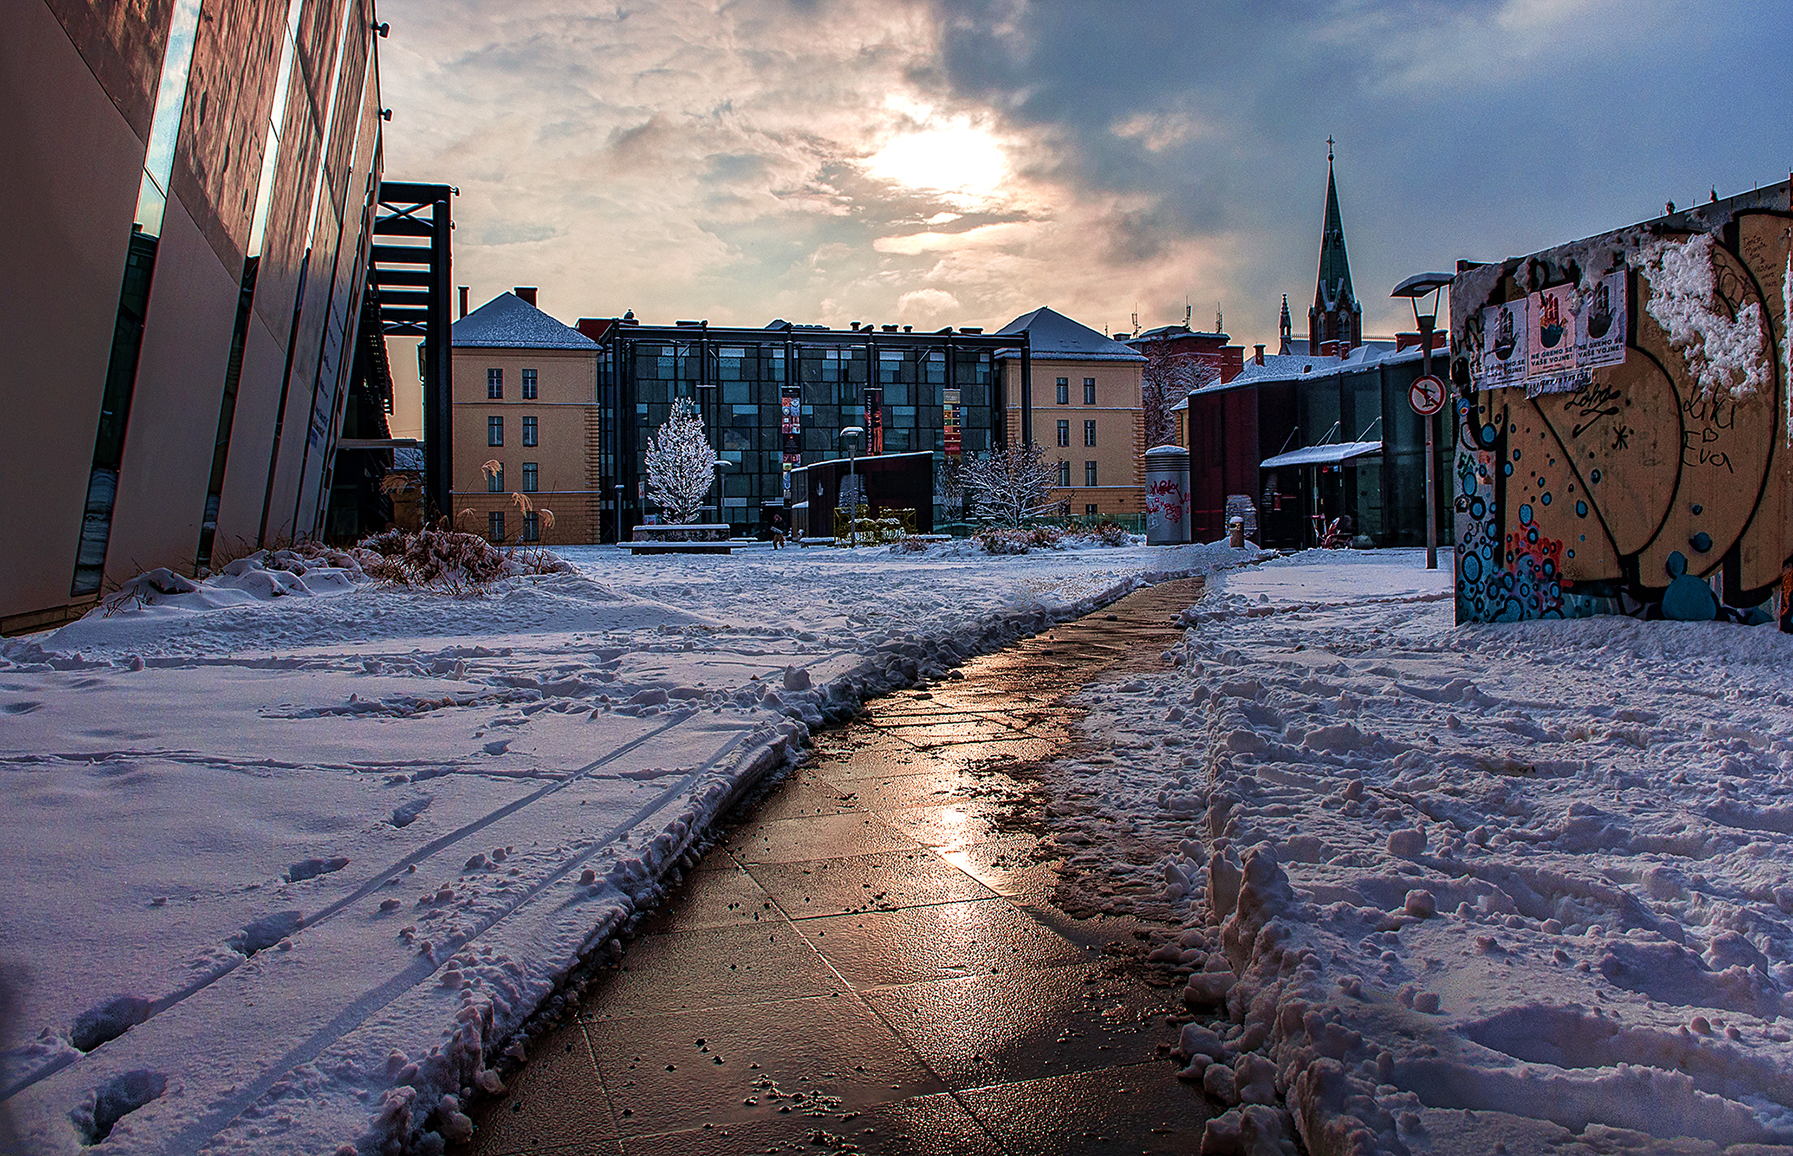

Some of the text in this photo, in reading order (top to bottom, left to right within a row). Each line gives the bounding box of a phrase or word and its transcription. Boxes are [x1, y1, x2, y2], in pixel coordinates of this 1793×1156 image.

[1589, 339, 1612, 348] GREMO
[1531, 352, 1539, 360] NE
[1541, 348, 1563, 358] GREMO
[1578, 349, 1594, 358] VAŠE
[1597, 344, 1623, 355] VOJNE!
[1531, 358, 1548, 367] VAŠE
[1549, 353, 1573, 364] VOJNE!
